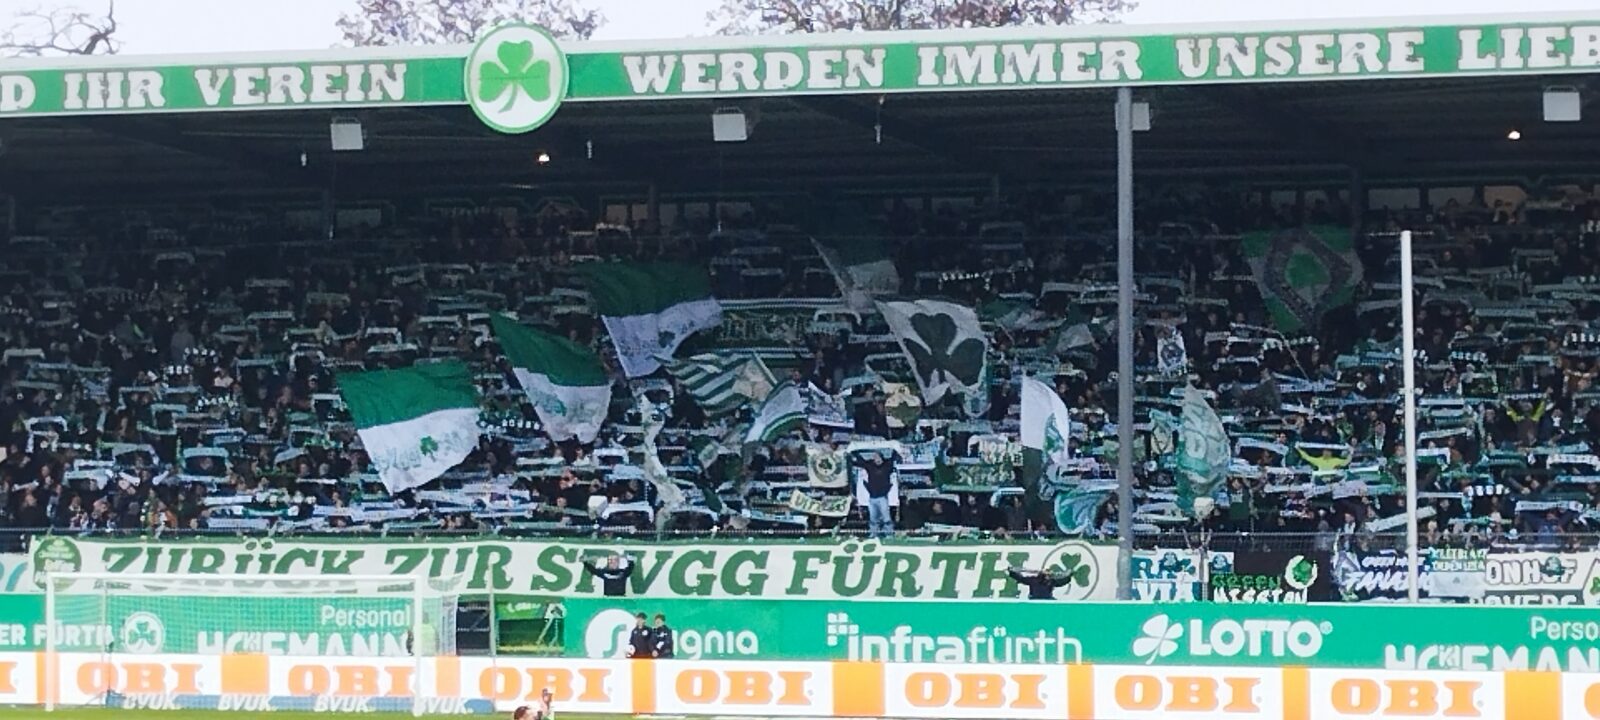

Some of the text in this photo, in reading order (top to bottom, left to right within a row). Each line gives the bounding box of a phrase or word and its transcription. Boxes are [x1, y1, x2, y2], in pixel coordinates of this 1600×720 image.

[63, 71, 166, 109] IHR
[194, 63, 407, 106] VEREIN
[622, 48, 886, 94] WERDEN
[917, 40, 1143, 86] IMMER
[1175, 30, 1425, 78] UNSERE
[101, 538, 364, 592] ZURÜCK
[377, 545, 513, 592] ZUR
[785, 541, 1030, 599] FÜRTH
[0, 624, 26, 646] ER
[321, 605, 410, 628] Personal
[848, 624, 1082, 663] infrafürth
[1189, 618, 1323, 657] LOTTO
[77, 662, 203, 694] OBI
[288, 664, 415, 697] OBI
[479, 666, 611, 702] OBI
[675, 669, 812, 705] OBI
[905, 672, 1047, 709] OBI
[1114, 675, 1261, 713] OBI
[1331, 678, 1483, 717] OBI
